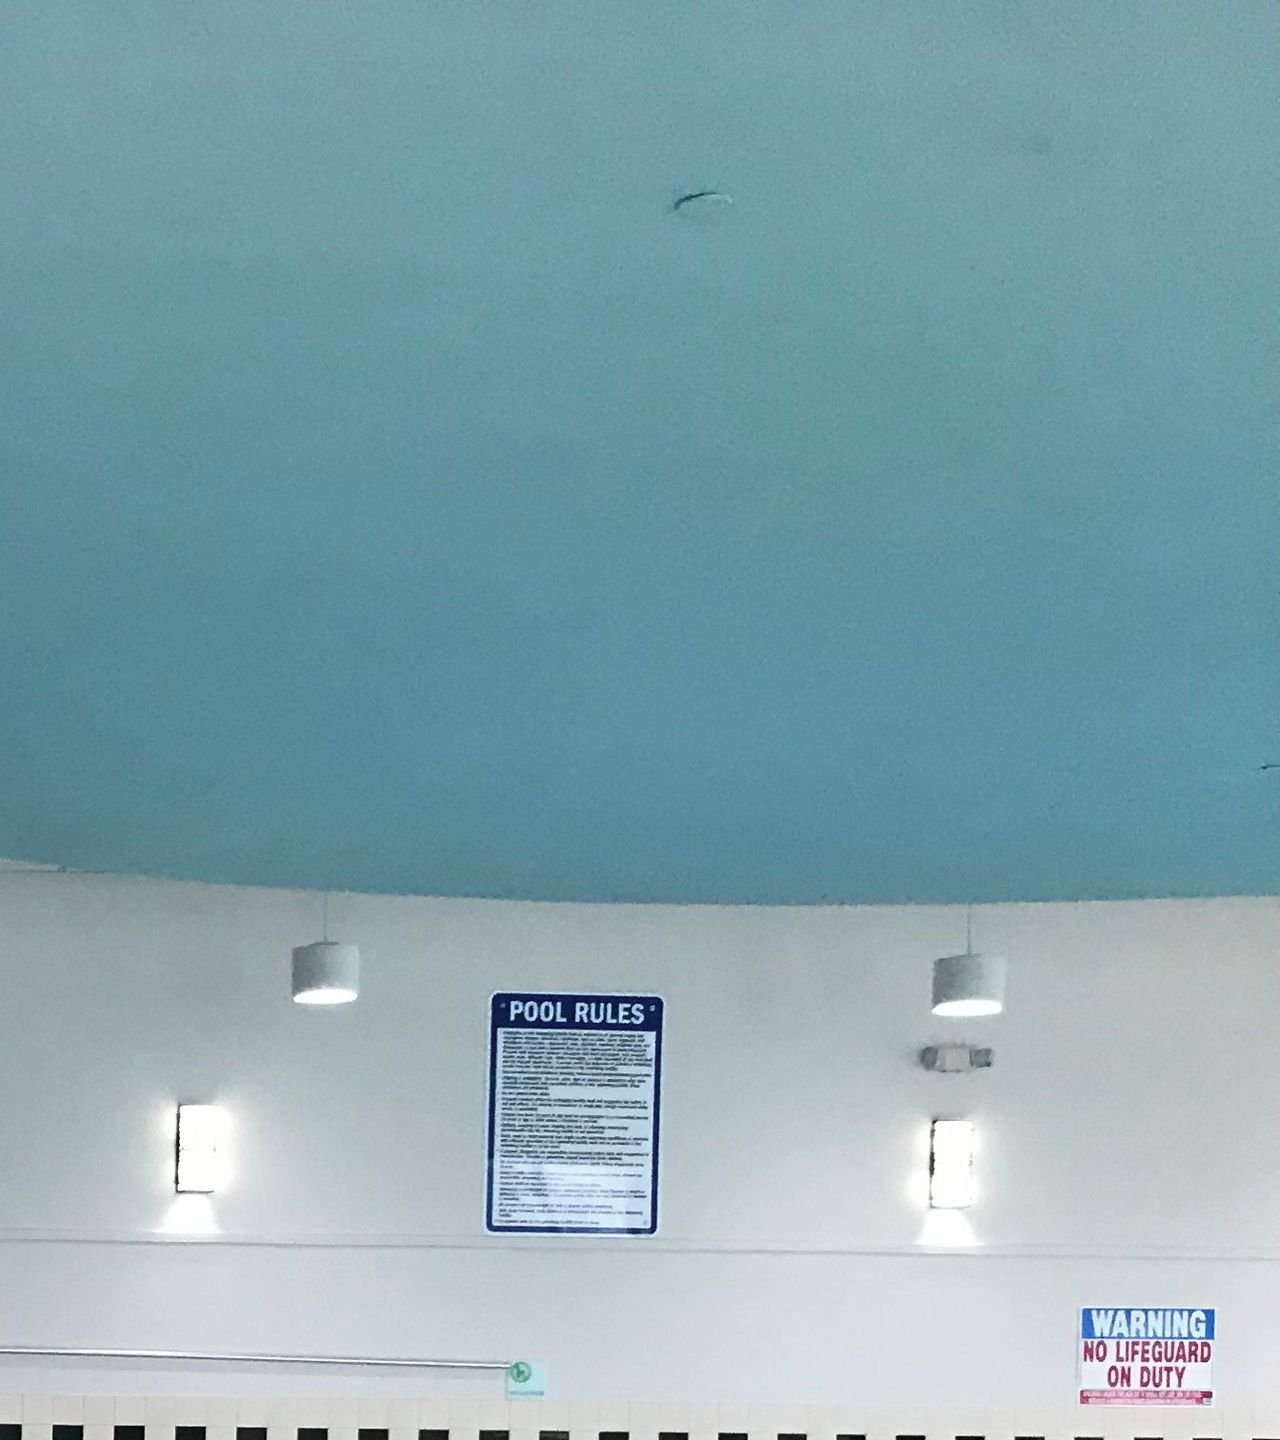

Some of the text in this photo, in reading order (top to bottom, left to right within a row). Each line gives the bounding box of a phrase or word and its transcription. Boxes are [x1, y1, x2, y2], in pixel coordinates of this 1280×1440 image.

[509, 1000, 645, 1025] POOL RULES
[1091, 1309, 1207, 1338] WARNING
[1083, 1340, 1212, 1363] NO LIFEGUARD
[1107, 1365, 1186, 1388] ON DUTY
